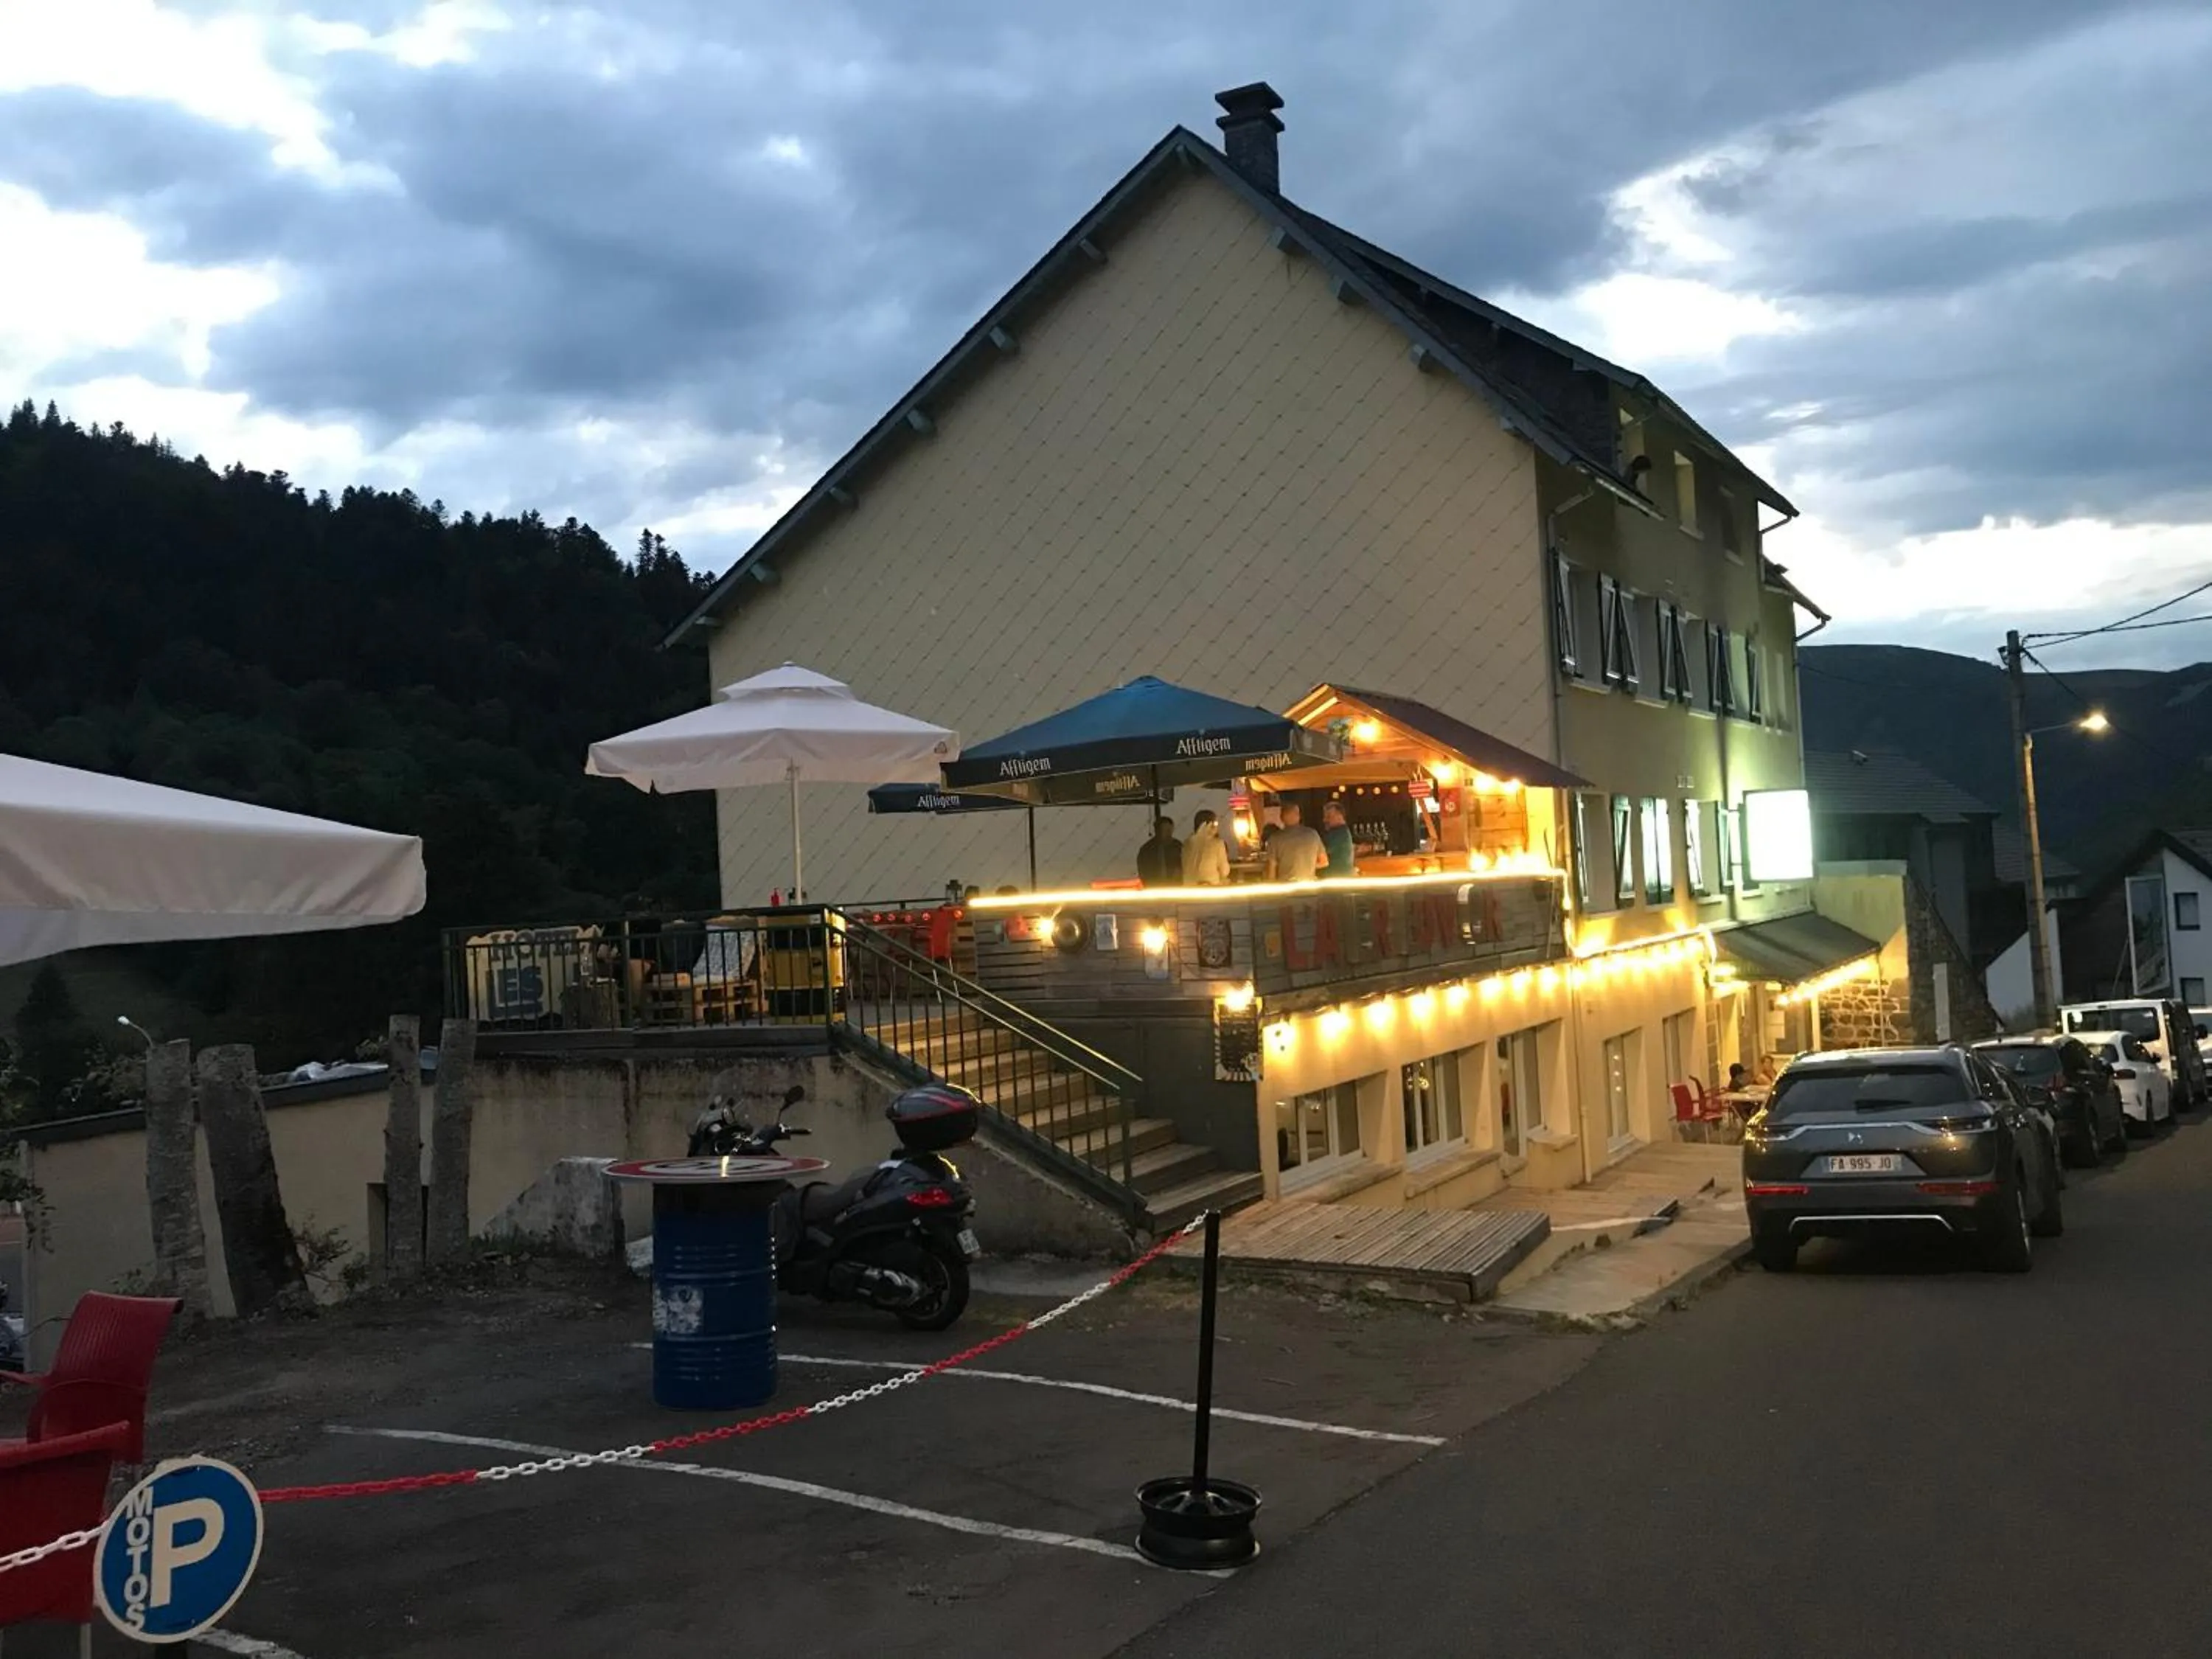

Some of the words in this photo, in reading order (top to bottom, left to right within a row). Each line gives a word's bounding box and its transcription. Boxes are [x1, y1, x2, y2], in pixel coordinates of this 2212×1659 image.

[1176, 737, 1231, 756] Affligem
[999, 757, 1051, 778] Affligem
[124, 1486, 153, 1632] MOTOS
[150, 1498, 224, 1608] P
